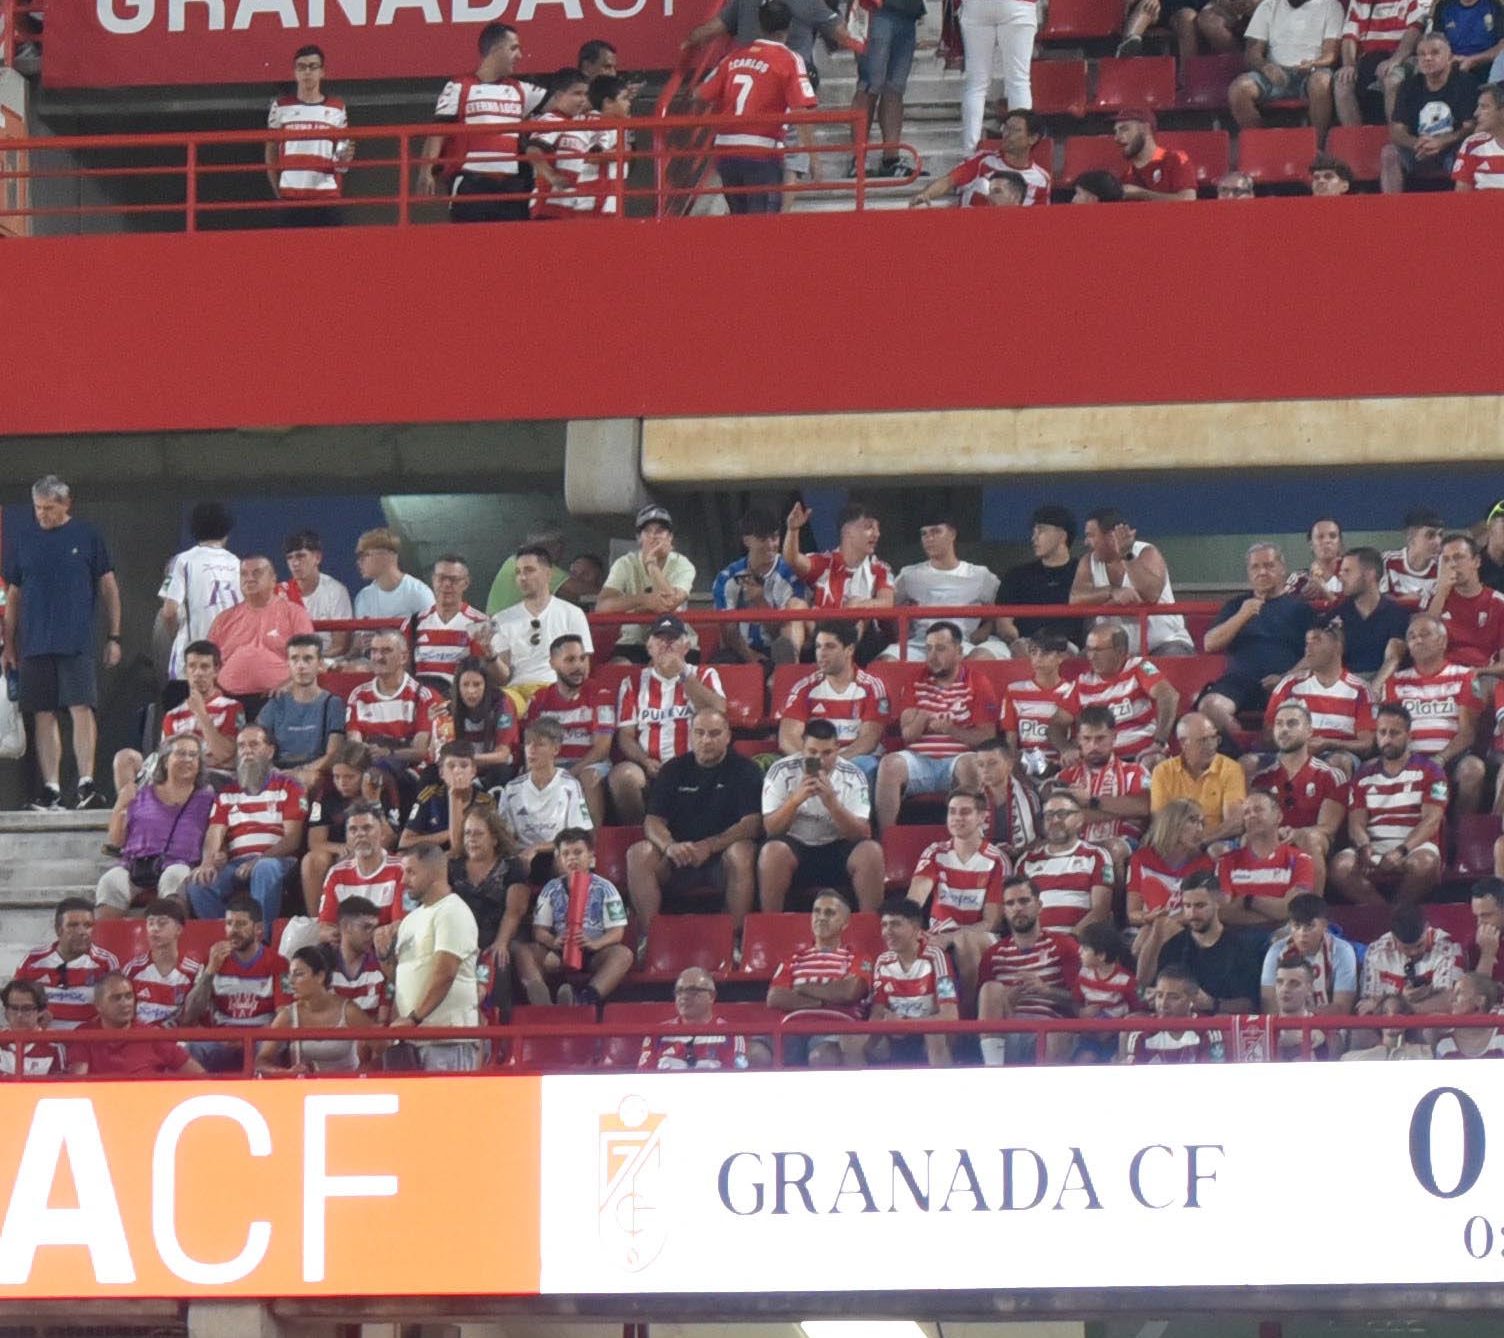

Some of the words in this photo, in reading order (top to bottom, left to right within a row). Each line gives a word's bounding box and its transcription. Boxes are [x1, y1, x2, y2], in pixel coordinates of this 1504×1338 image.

[733, 74, 754, 116] 7
[1403, 698, 1455, 717] Platzi
[1408, 1084, 1485, 1200] 0
[718, 1147, 1105, 1218] GRANADA
[1127, 1144, 1226, 1211] CF
